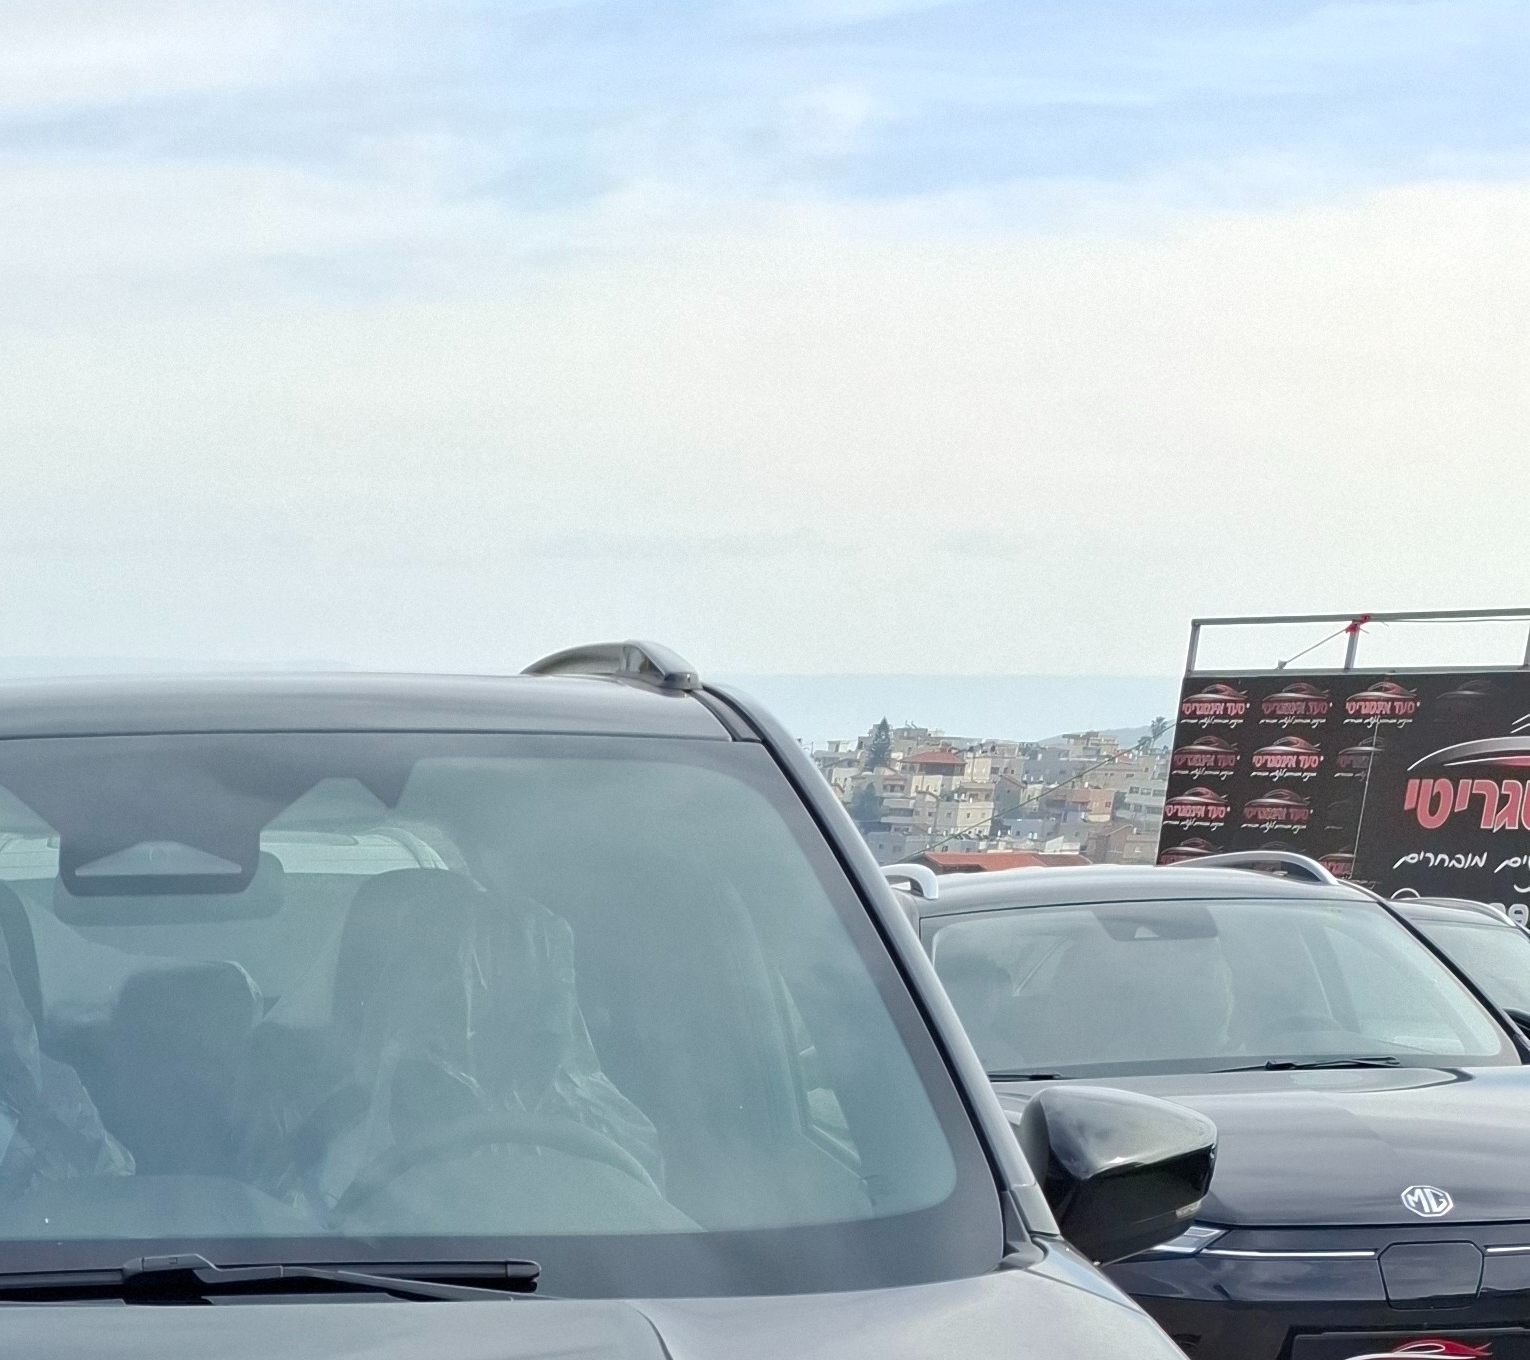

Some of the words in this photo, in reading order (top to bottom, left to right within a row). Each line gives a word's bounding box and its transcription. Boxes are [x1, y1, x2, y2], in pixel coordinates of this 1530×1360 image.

[1404, 777, 1530, 833] גריטי
[1393, 850, 1488, 869] מובחרים
[1405, 1187, 1449, 1214] MG
